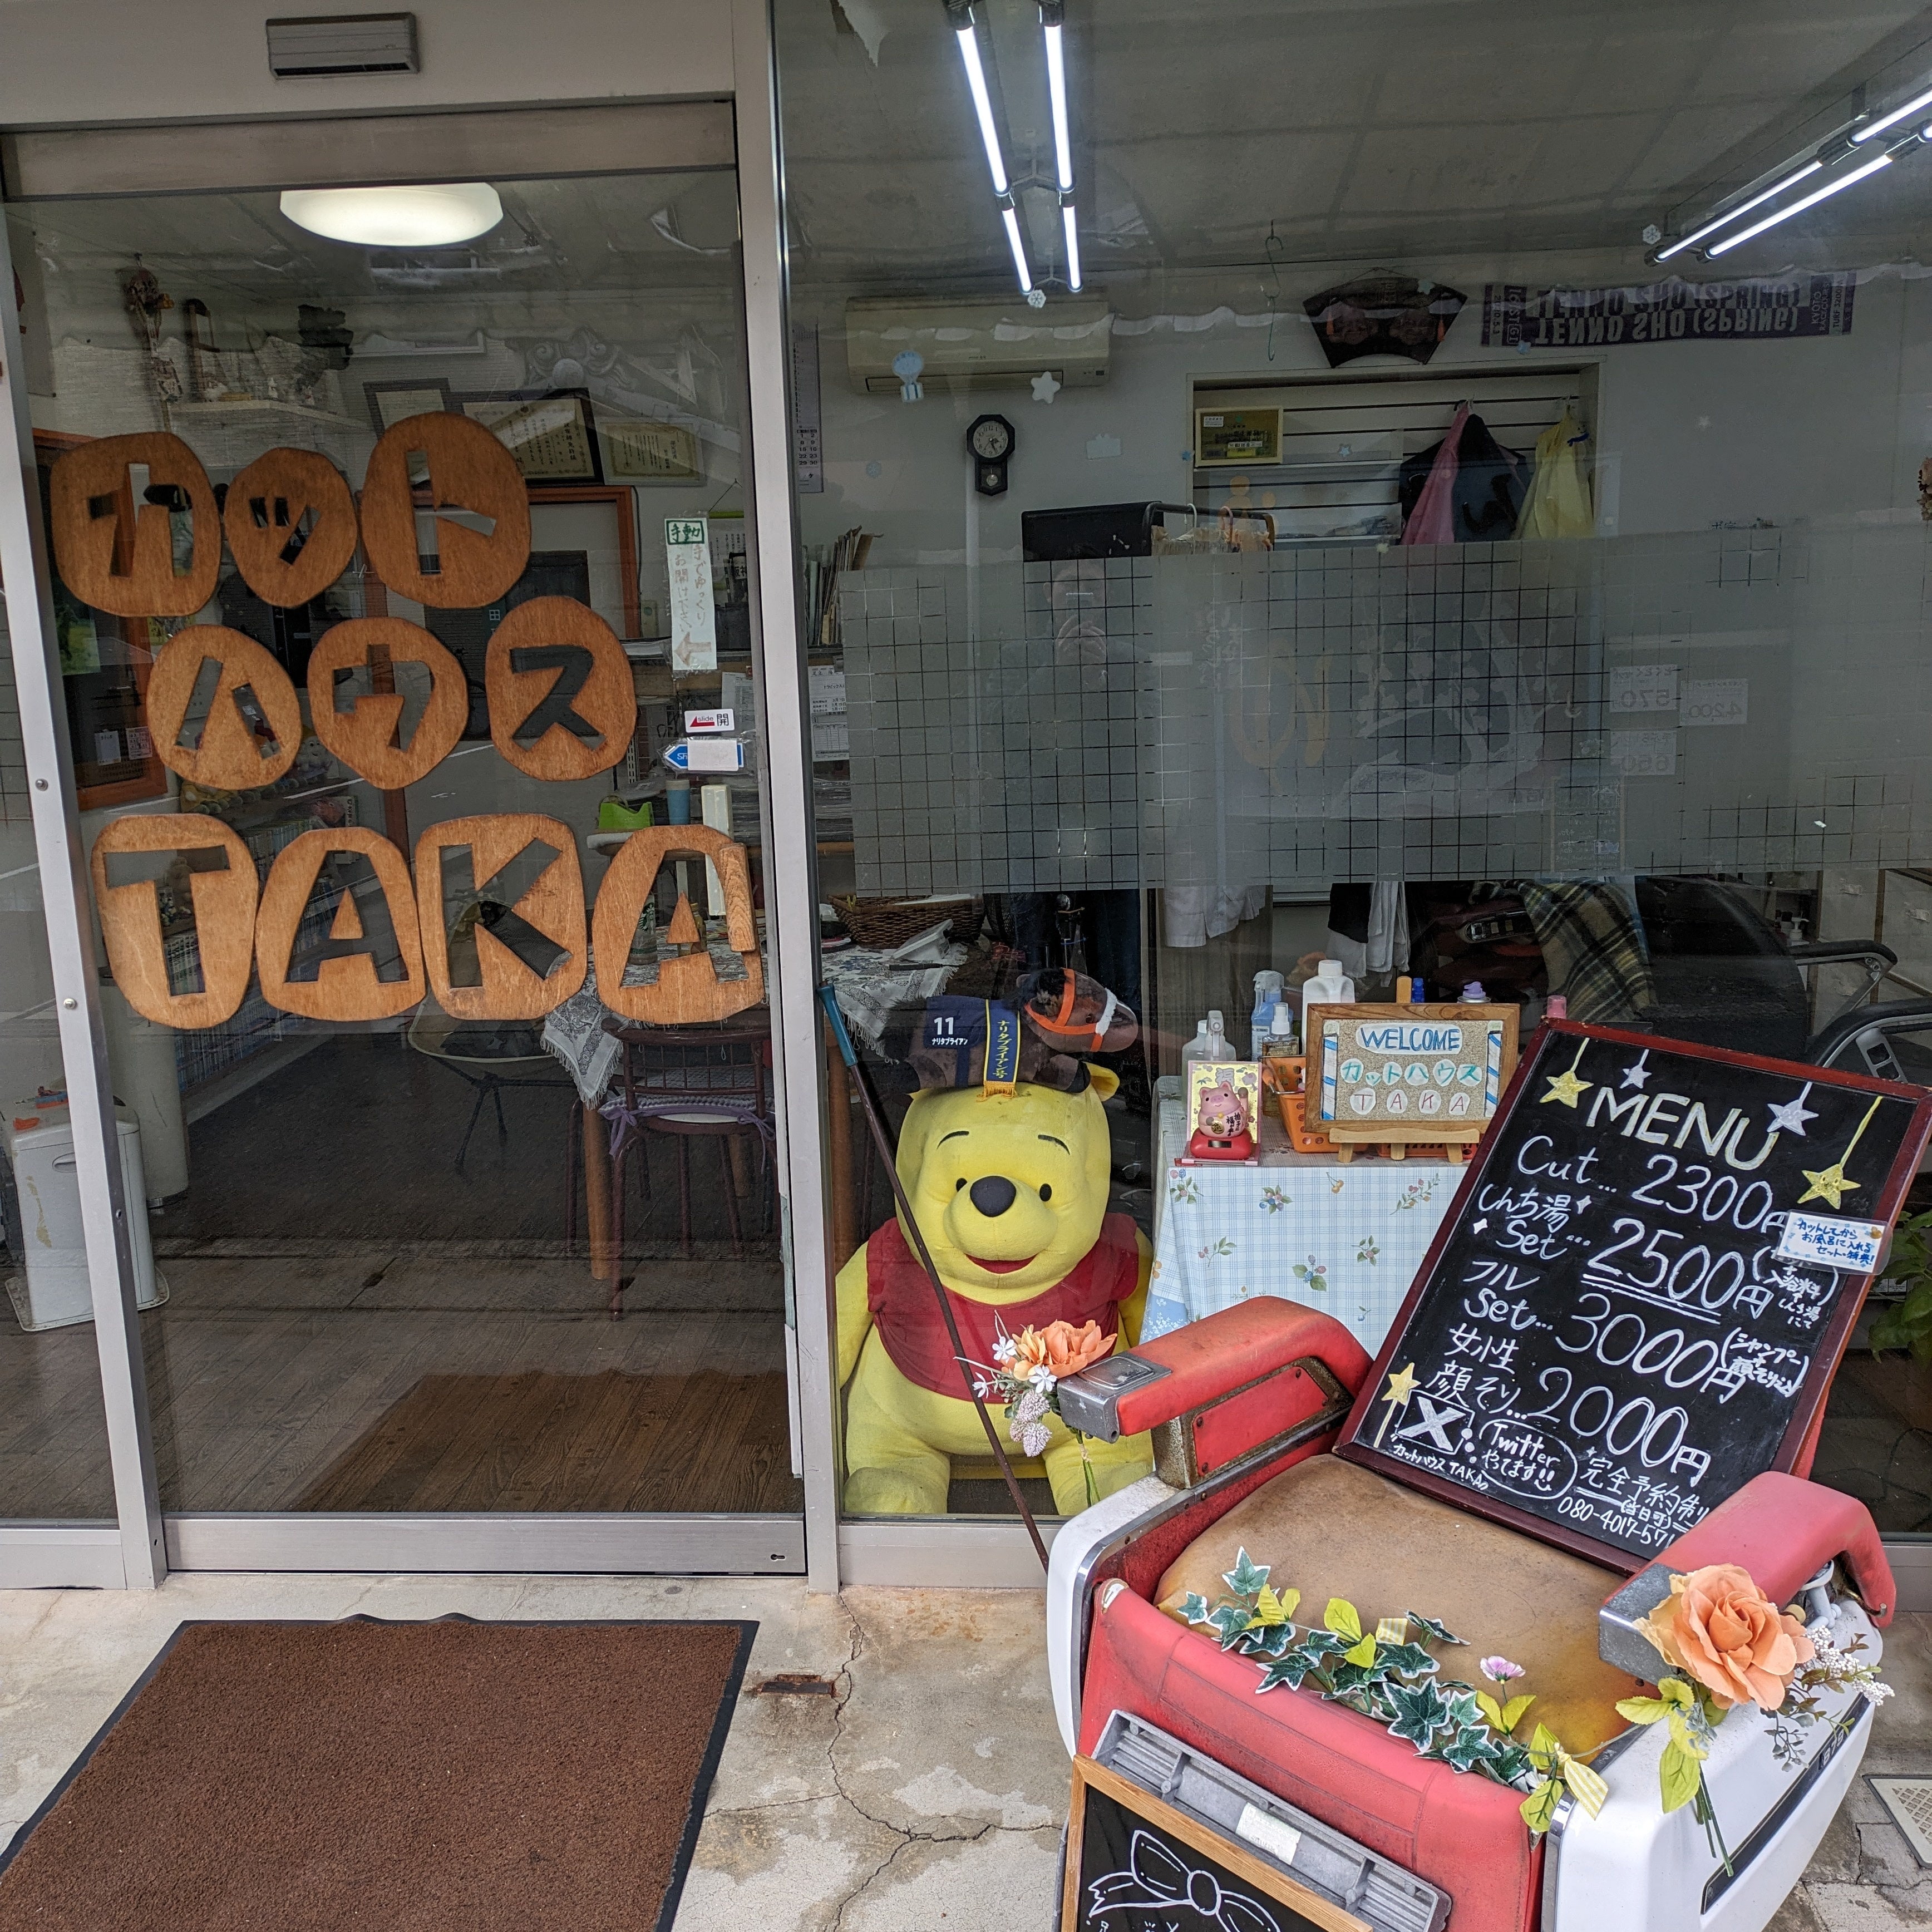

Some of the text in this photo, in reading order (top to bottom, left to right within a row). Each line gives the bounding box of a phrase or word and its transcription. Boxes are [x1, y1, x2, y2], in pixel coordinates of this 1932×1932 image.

[87, 451, 497, 577] カット
[671, 523, 701, 542] 手動
[693, 544, 707, 627] 手でゆっくり
[174, 644, 607, 759] ハウス
[716, 713, 729, 726] 開
[103, 837, 750, 996] TAKA
[931, 1037, 968, 1046] ナリタブライアン
[934, 1017, 954, 1036] 11
[992, 1020, 1012, 1079] ナリタブライアン号
[1360, 1026, 1461, 1052] WELCOME
[1342, 1062, 1480, 1085] カットハウス
[1353, 1092, 1465, 1112] TAKA
[1586, 1087, 1780, 1171] MENU
[1478, 1182, 1573, 1233] しんち湯
[1797, 1220, 1858, 1240] カットしてから
[1801, 1233, 1875, 1253] お風呂に入れる
[1462, 1260, 1541, 1291] フル
[1588, 1218, 1775, 1319] 2500円
[1787, 1315, 1812, 1329] にて
[1443, 1322, 1519, 1374] 女性
[1555, 1293, 1747, 1404] 3000円
[1494, 1422, 1561, 1468] Twitter
[1527, 1366, 1712, 1487] 2000円
[1393, 1443, 1447, 1472] カットハウス
[1579, 1457, 1710, 1528] 完全予約制
